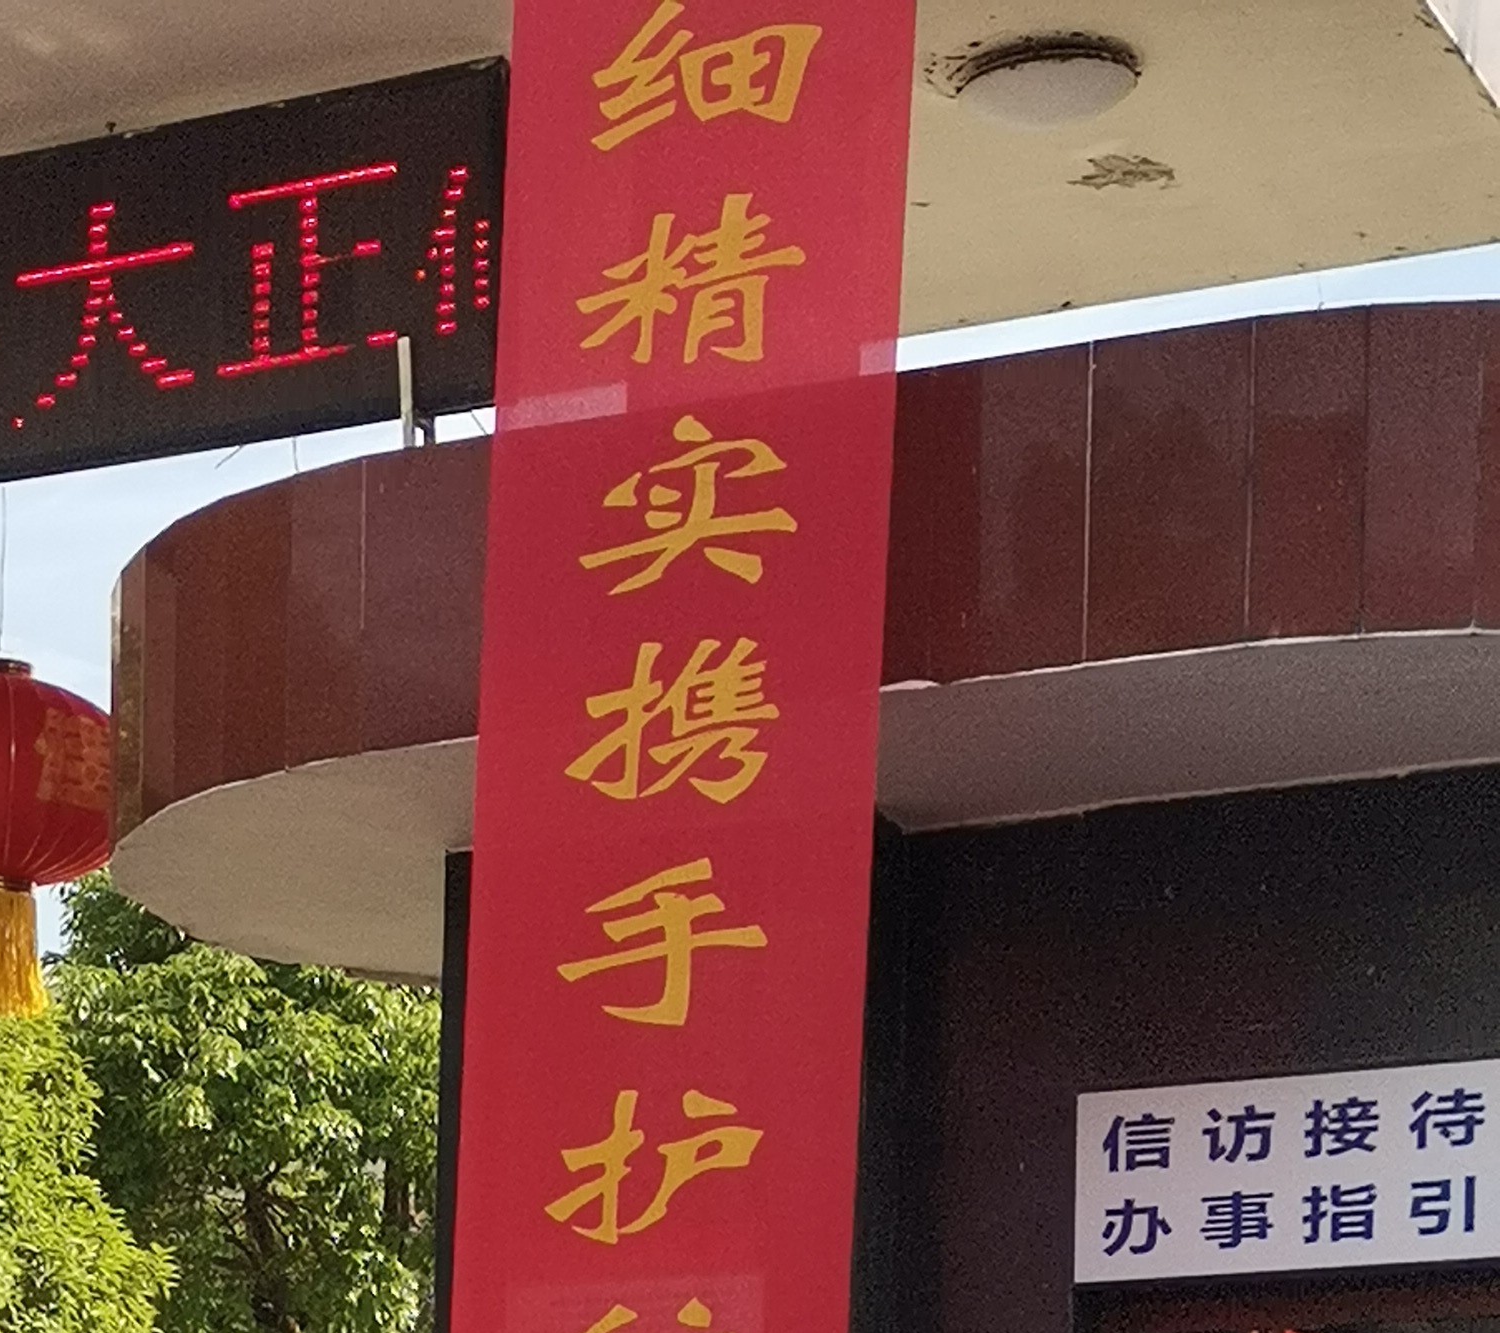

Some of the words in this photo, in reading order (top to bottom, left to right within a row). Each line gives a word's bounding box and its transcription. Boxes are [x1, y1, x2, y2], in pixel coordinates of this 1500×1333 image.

[1102, 1087, 1486, 1173] 信访接待
[1101, 1175, 1477, 1256] 办事指引
